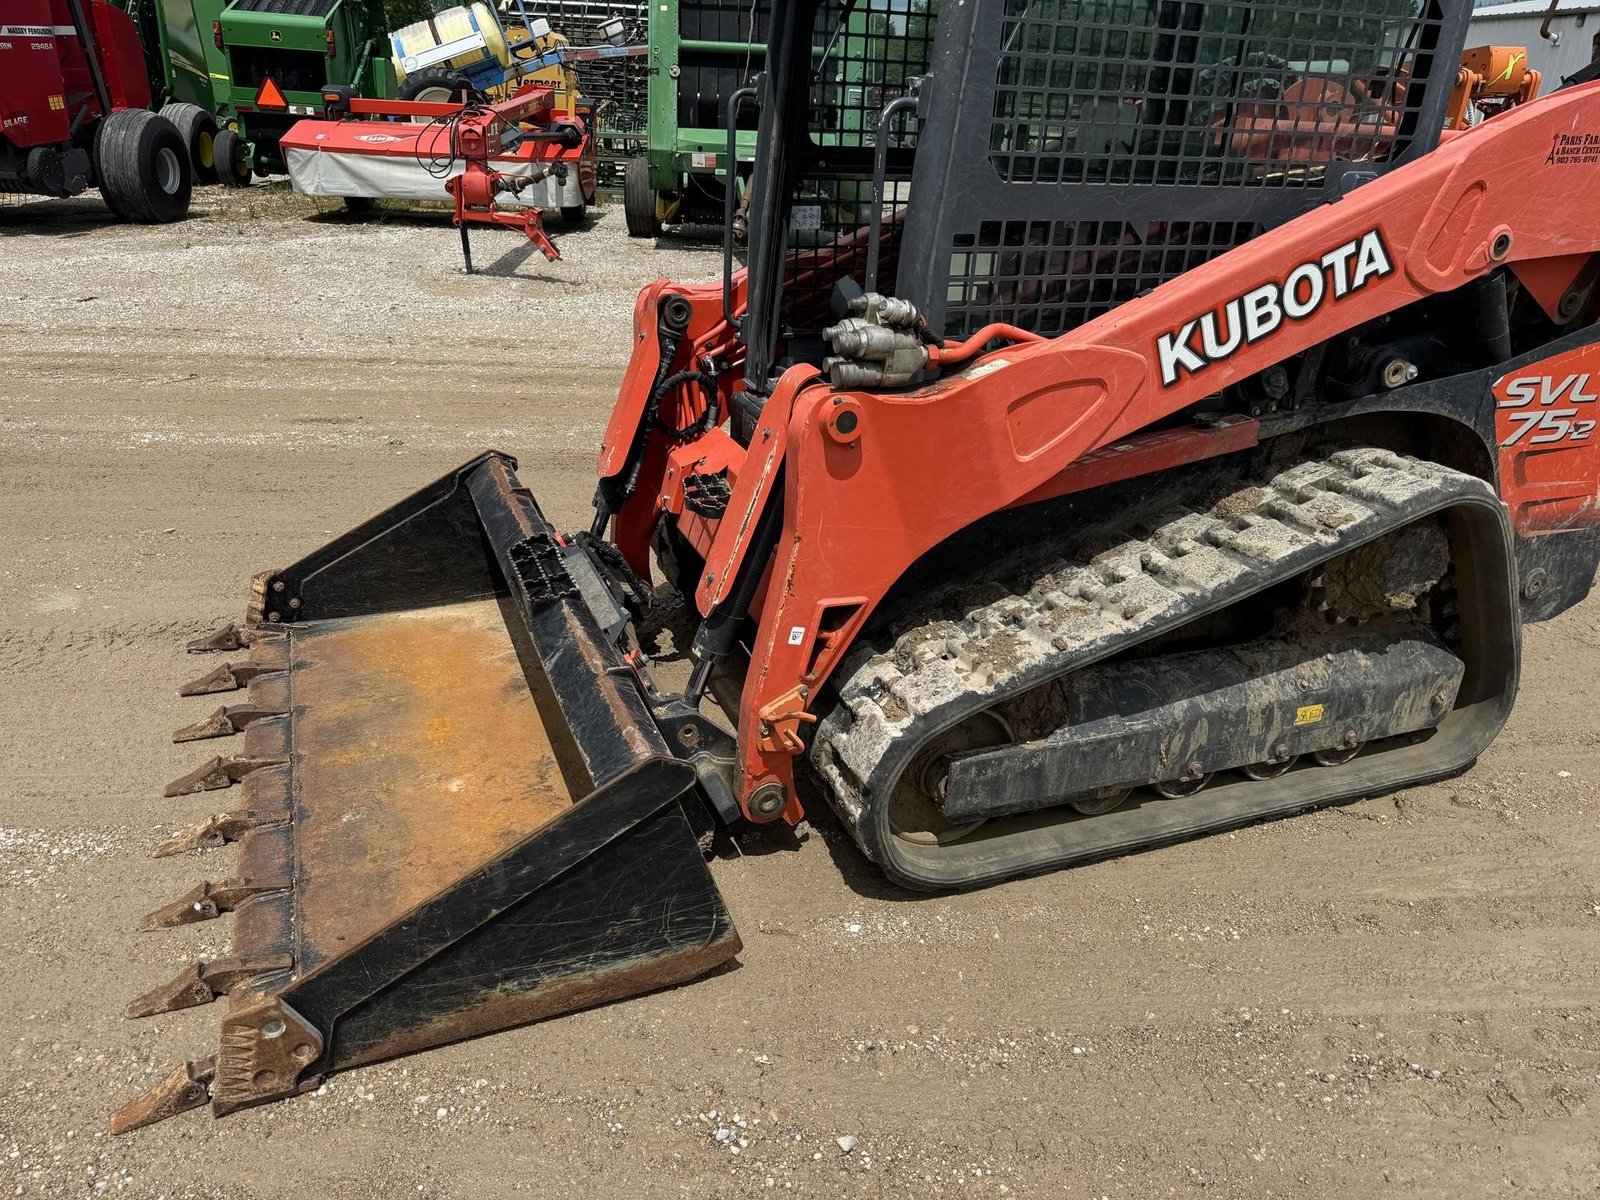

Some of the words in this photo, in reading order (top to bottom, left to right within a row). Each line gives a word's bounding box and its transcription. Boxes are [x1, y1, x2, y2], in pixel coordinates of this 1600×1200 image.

[28, 27, 53, 35] FERGUSON
[31, 42, 54, 50] 2946A
[516, 75, 561, 88] Vermeer
[1560, 134, 1583, 145] PARIS
[1583, 133, 1600, 145] FAR
[1560, 146, 1581, 155] RANCH
[1156, 229, 1392, 386] KUBOTA
[1496, 373, 1598, 409] SVL
